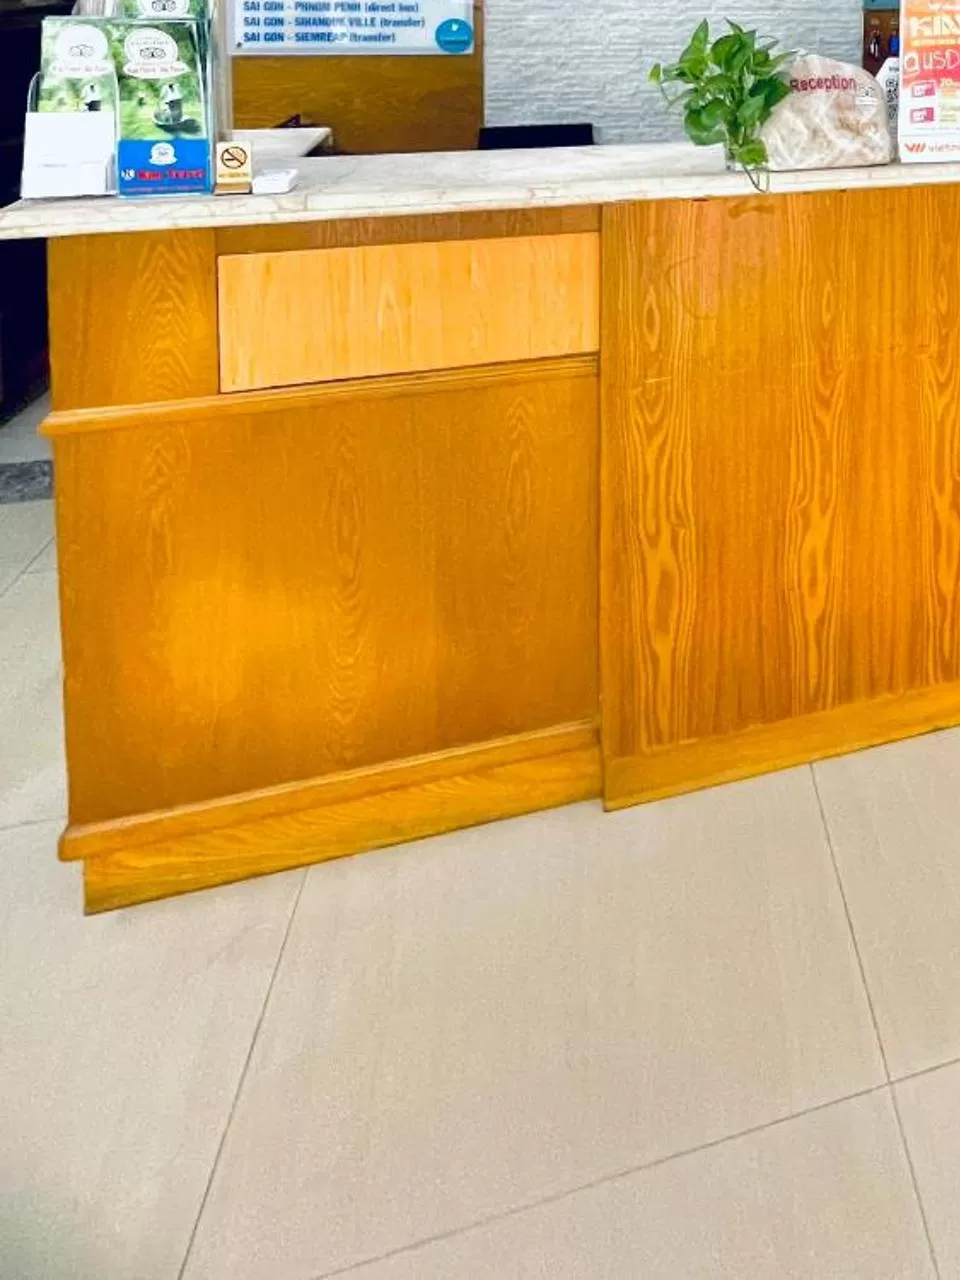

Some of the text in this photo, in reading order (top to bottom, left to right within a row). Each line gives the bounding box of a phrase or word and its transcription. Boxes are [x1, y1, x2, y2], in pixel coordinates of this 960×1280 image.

[243, 1, 260, 11] SAI
[263, 1, 284, 11] GON
[243, 17, 260, 27] SAI
[263, 17, 284, 27] GON
[243, 32, 260, 42] SAI
[263, 32, 284, 42] GON
[922, 48, 960, 70] USD
[790, 75, 857, 92] Reception
